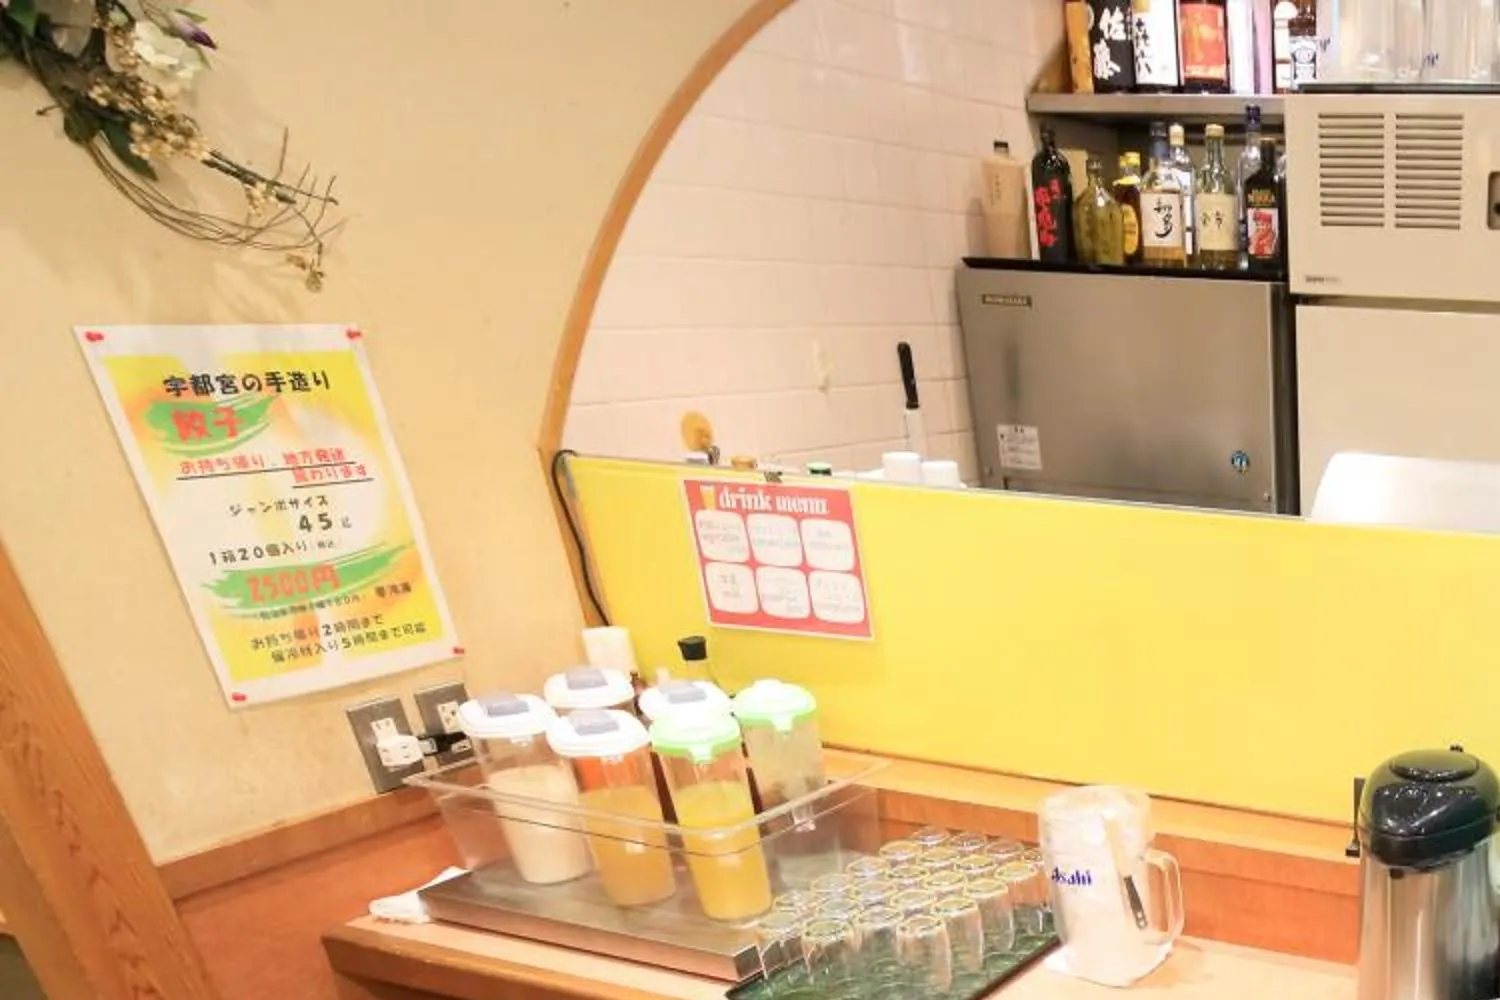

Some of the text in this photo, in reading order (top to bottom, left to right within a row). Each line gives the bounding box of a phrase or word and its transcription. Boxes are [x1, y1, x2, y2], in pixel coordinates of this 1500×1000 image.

[163, 371, 331, 398] 宇都宮の手造り
[171, 406, 244, 442] 餃子
[719, 488, 830, 515] drink menu
[246, 563, 341, 604] 2500円
[1051, 866, 1092, 886] Asahi
